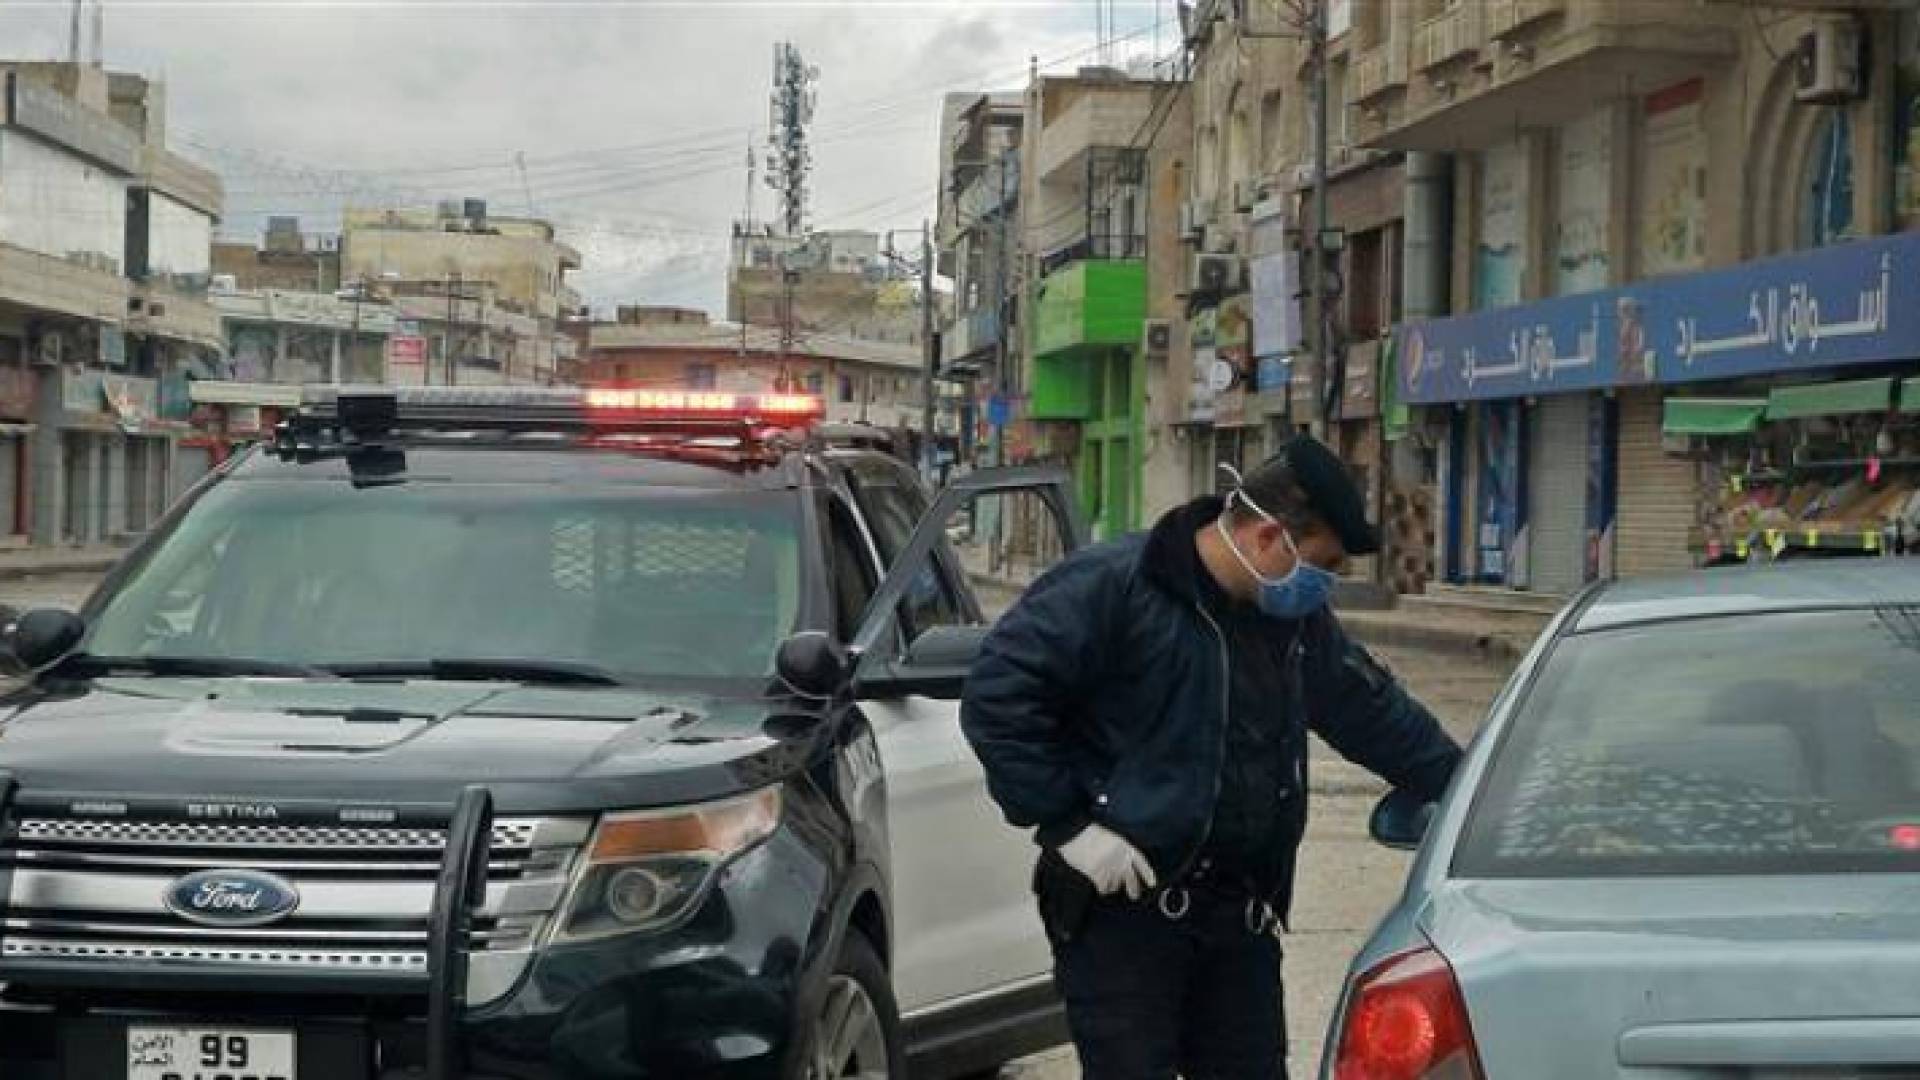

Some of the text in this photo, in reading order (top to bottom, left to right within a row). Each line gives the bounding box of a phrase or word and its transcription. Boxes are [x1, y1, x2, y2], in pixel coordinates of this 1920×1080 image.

[1783, 252, 1890, 354] أسواق
[192, 882, 262, 912] Ford
[201, 1035, 249, 1067] 99
